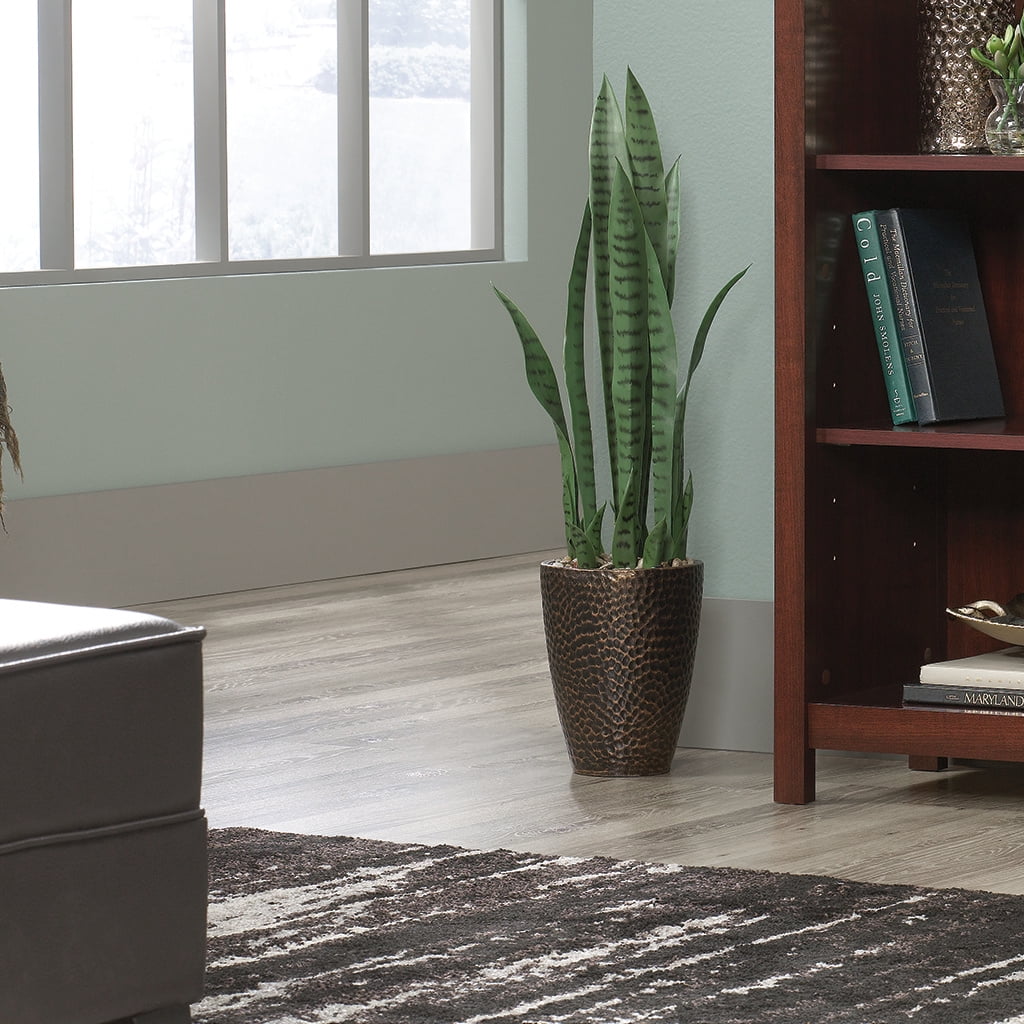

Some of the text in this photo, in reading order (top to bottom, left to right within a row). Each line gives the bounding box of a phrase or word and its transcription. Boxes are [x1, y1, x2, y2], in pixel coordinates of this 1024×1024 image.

[856, 218, 881, 282] Cold
[893, 244, 904, 280] Macmillan
[900, 282, 911, 316] Dictionary
[906, 318, 914, 328] for
[873, 294, 895, 376] JOHN SMOLENS
[964, 692, 1024, 707] MARYLAND
